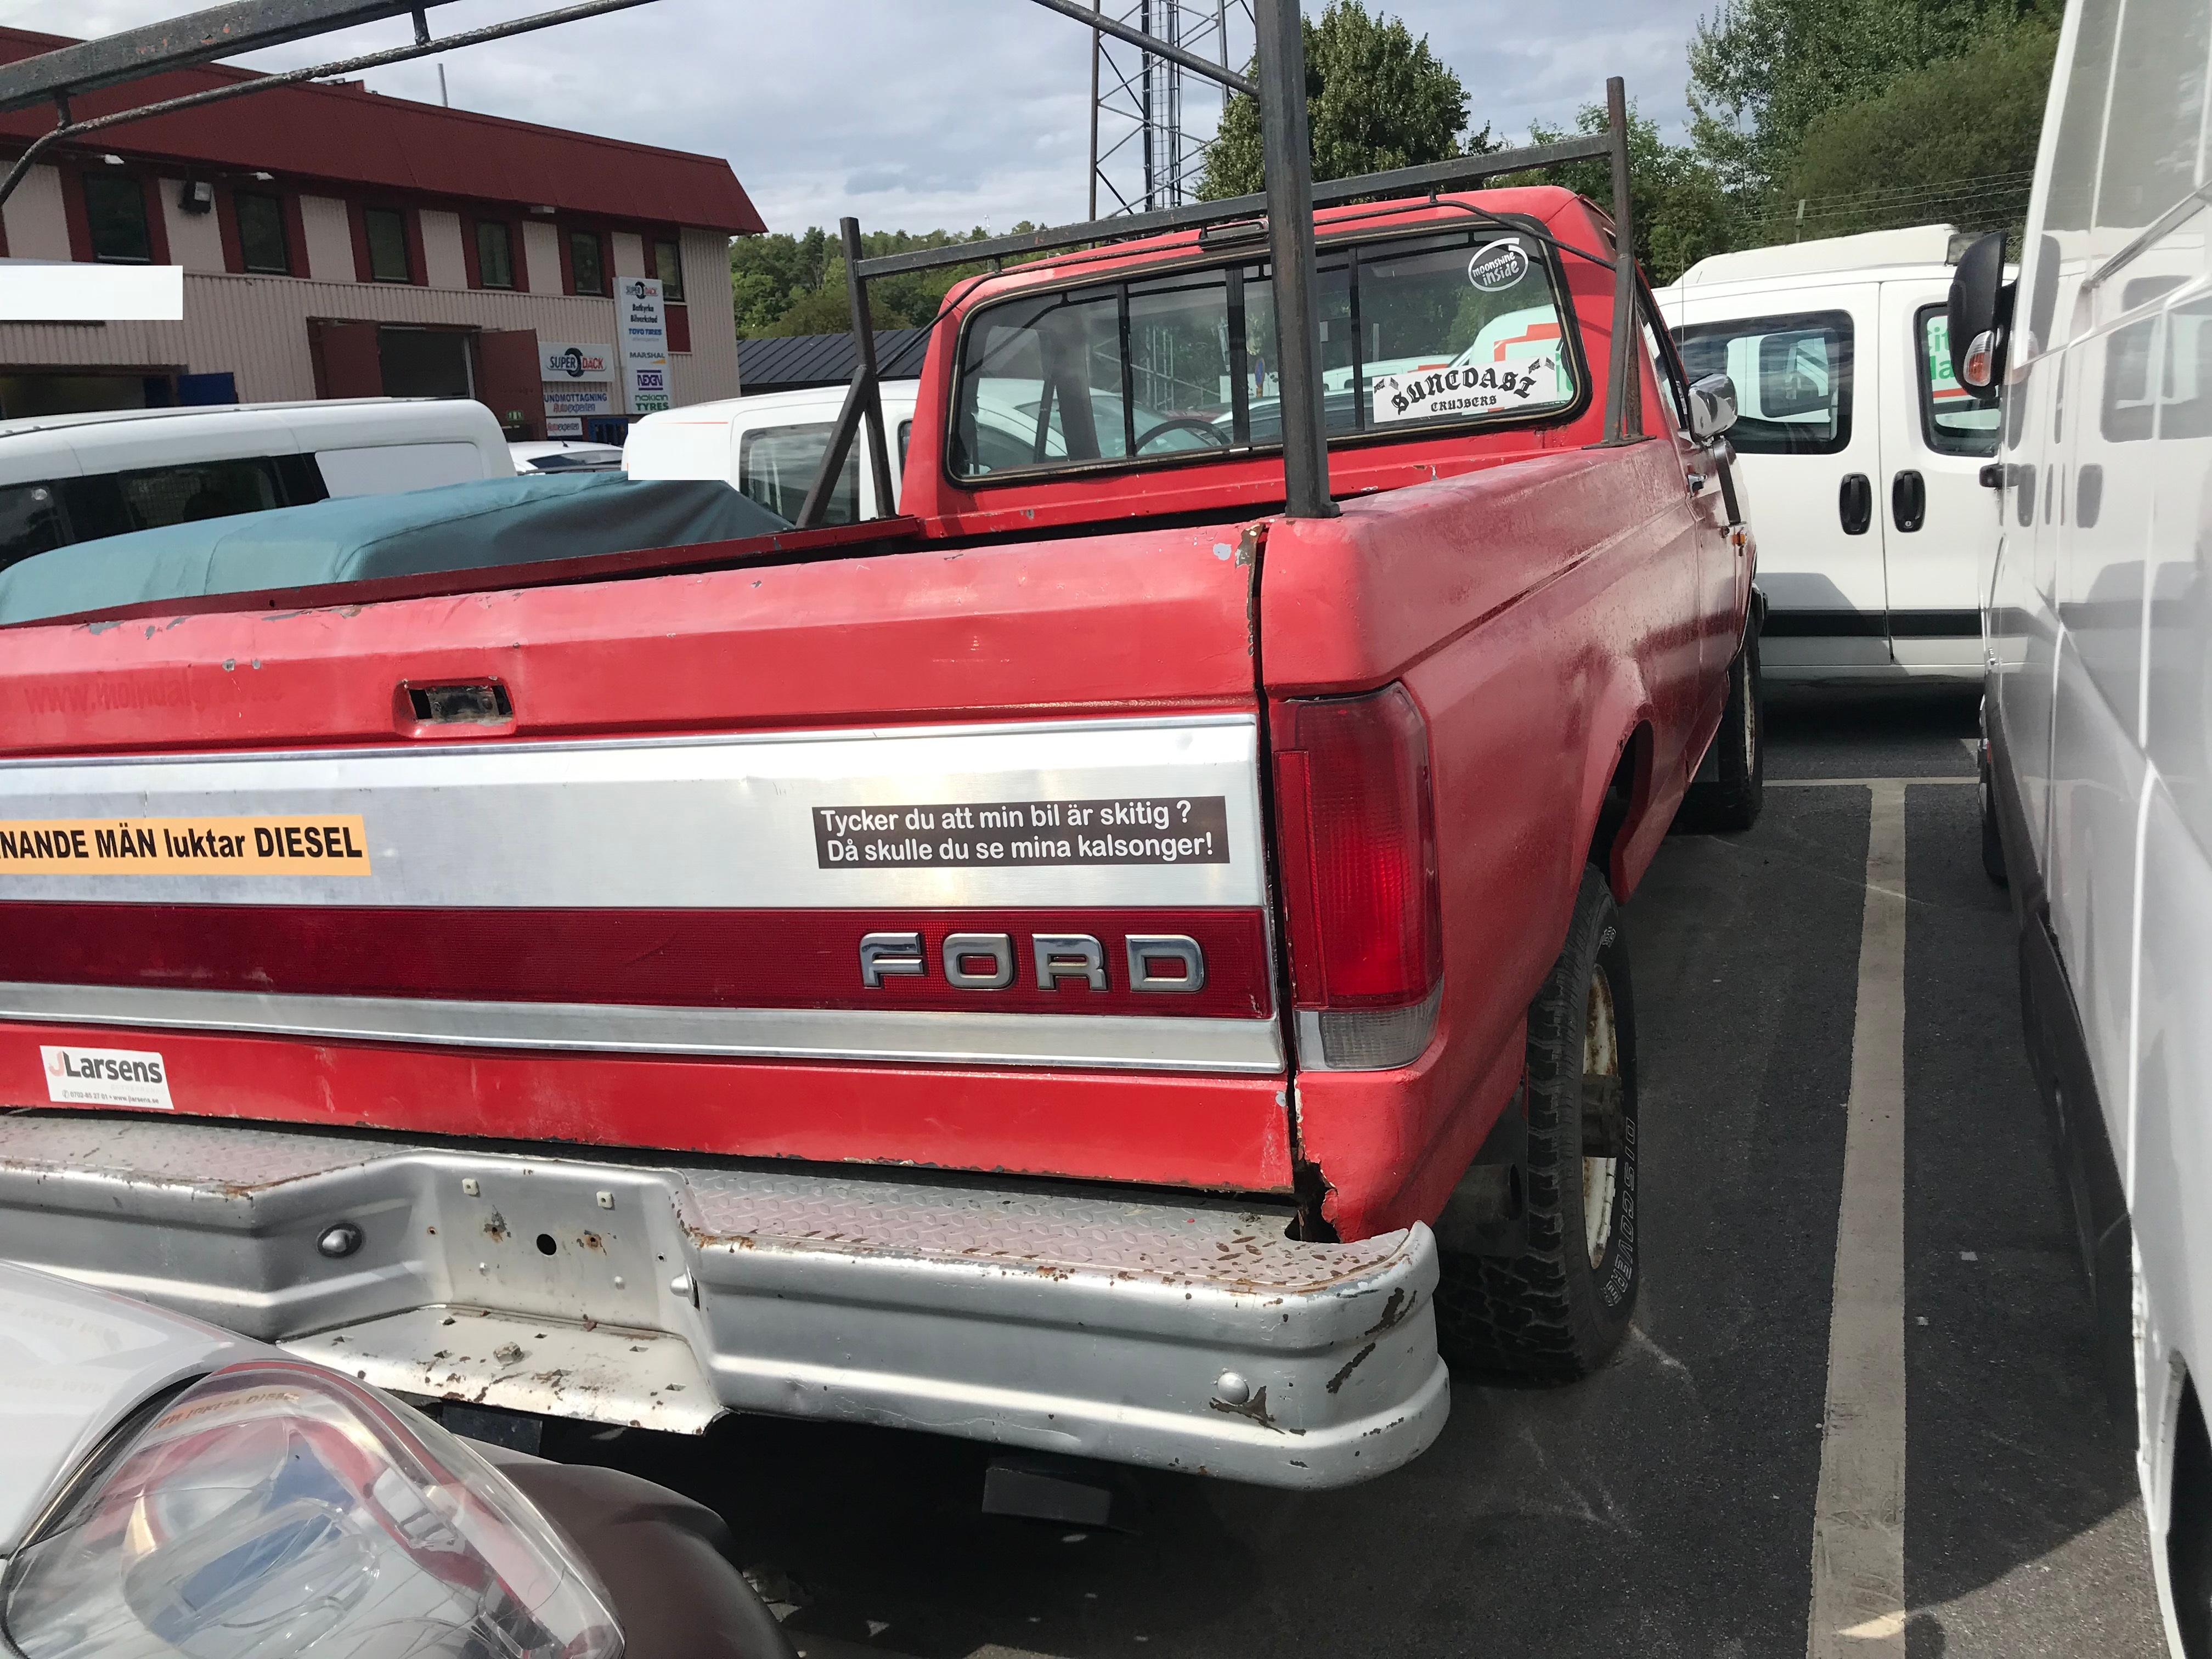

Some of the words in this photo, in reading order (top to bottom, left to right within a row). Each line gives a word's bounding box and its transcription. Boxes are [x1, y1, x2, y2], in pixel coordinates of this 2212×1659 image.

[1472, 252, 1515, 278] moonshine
[1482, 261, 1519, 286] inside
[550, 356, 575, 369] SUPER
[582, 357, 603, 369] DÄCK
[1391, 367, 1537, 415] SUNCOAST
[1430, 395, 1497, 412] CRUISERS
[636, 402, 669, 411] TYRES
[820, 809, 899, 837] Tycker
[905, 808, 934, 830] du
[941, 807, 974, 829] att
[979, 805, 1024, 828] min
[1030, 804, 1060, 827] bil
[1067, 804, 1093, 826] är
[1100, 802, 1170, 830] skitig
[1176, 800, 1192, 823] ?
[0, 830, 89, 859] NANDE
[94, 822, 157, 859] MÄN
[163, 828, 245, 858] luktar
[254, 826, 363, 858] DIESEL
[827, 838, 859, 861] Då
[865, 838, 933, 861] skulle
[939, 838, 969, 860] du
[976, 842, 1004, 859] se
[1011, 836, 1071, 859] mina
[1077, 831, 1214, 861] kalsonger!
[859, 932, 1205, 992] FORD
